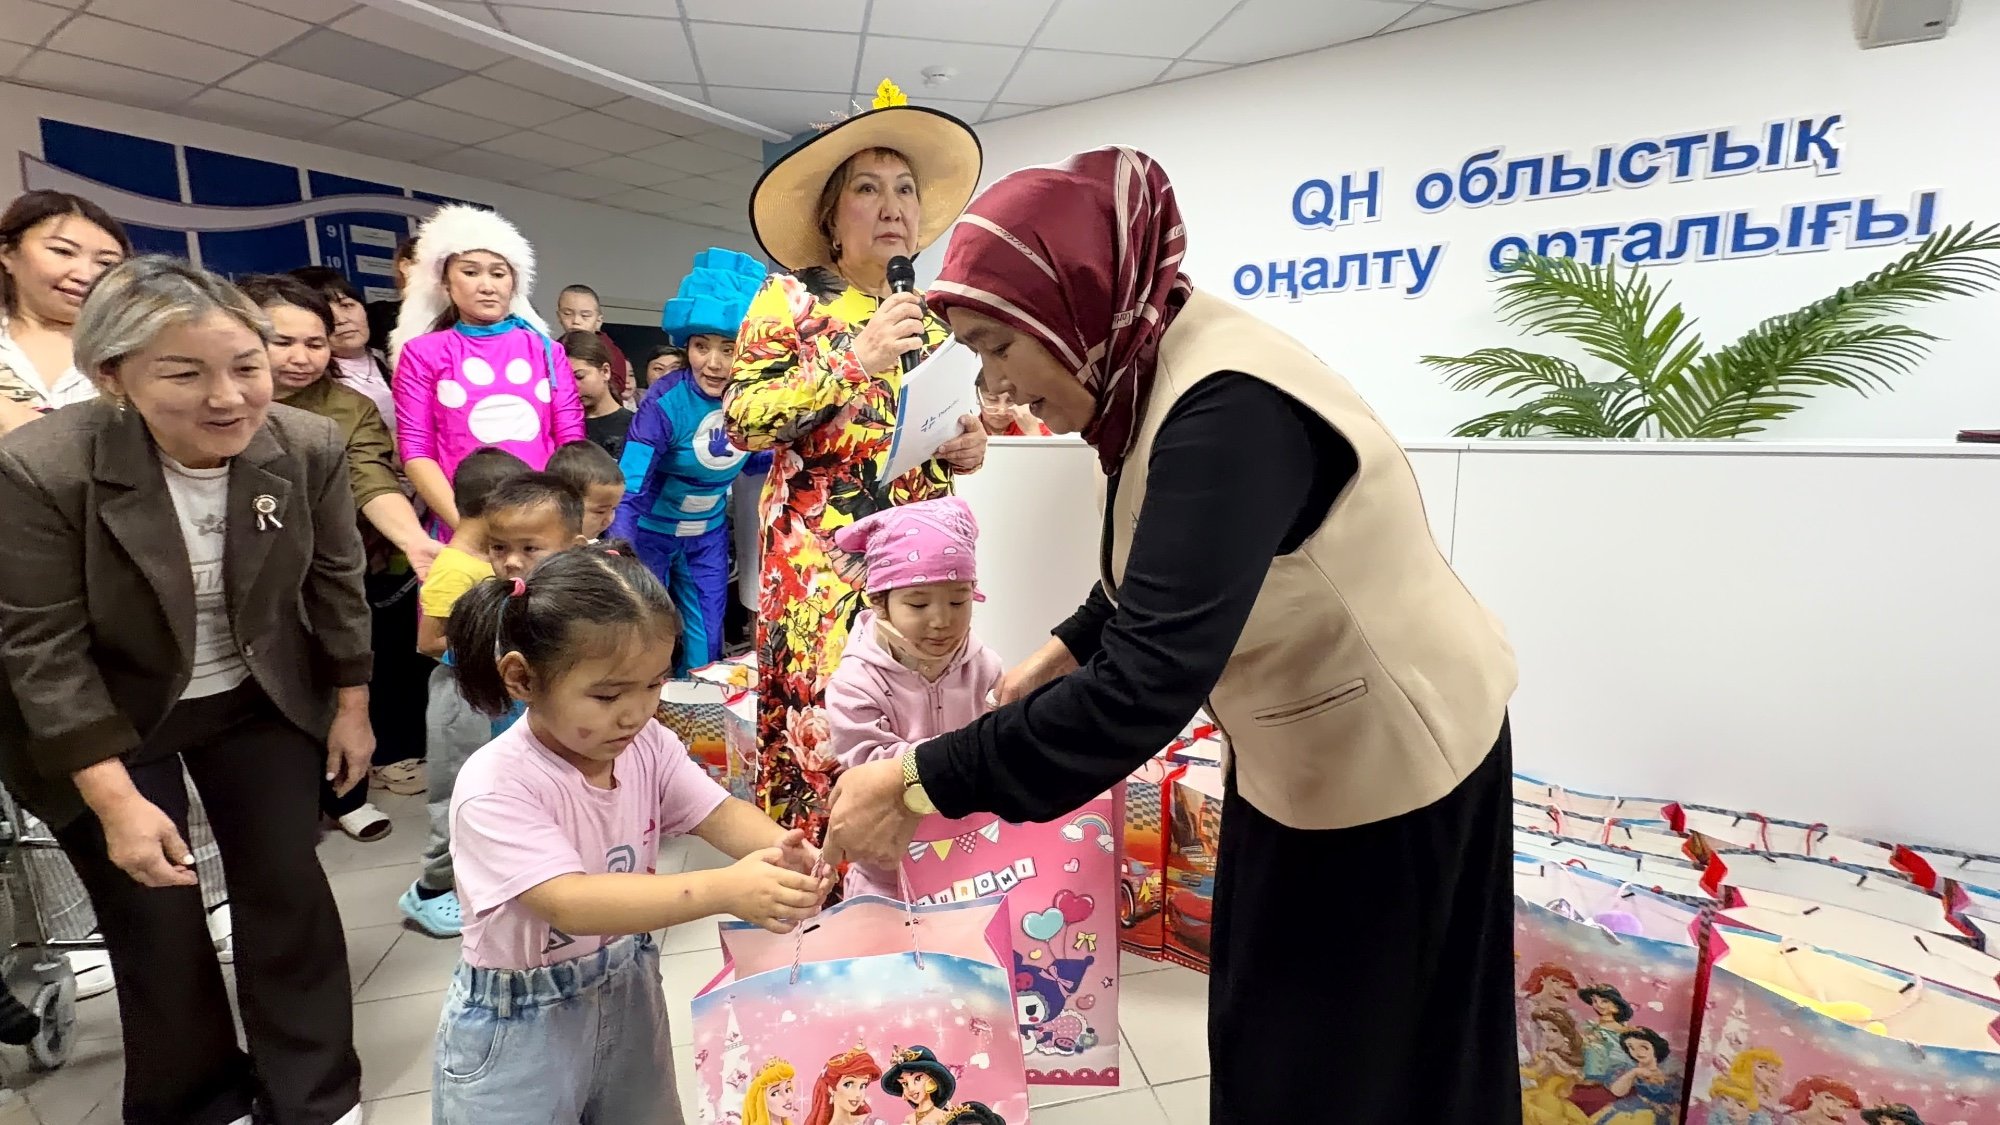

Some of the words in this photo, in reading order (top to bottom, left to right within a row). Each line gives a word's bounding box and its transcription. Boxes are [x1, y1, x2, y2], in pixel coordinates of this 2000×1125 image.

[1416, 114, 1842, 210] облыстық
[326, 225, 337, 238] 9
[1233, 245, 1442, 298] оңалту
[1489, 192, 1936, 273] орталығы
[326, 255, 342, 269] 10
[919, 862, 1028, 905] UROMI
